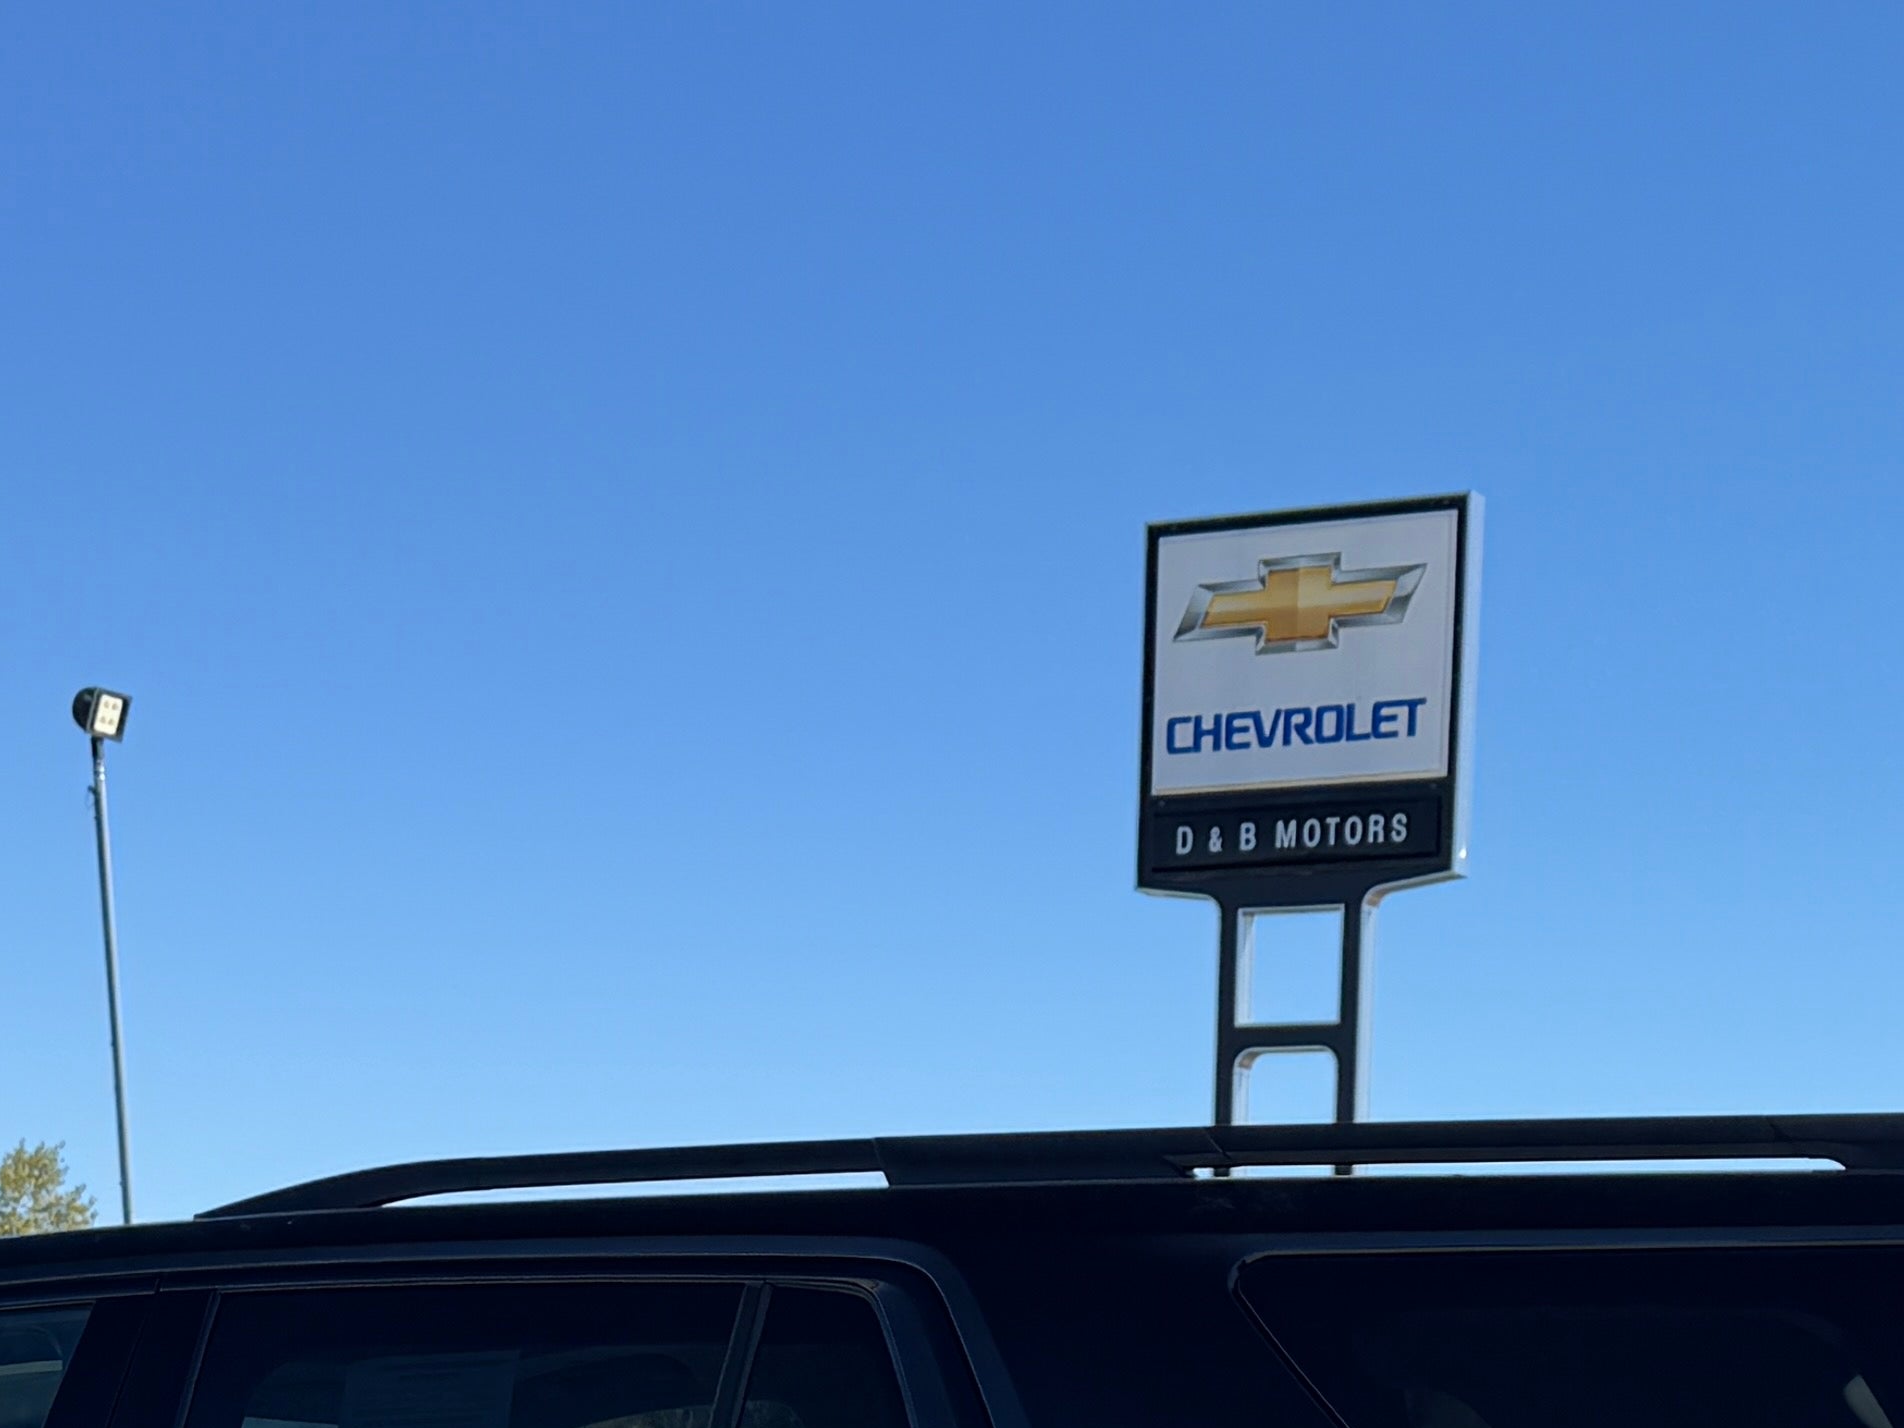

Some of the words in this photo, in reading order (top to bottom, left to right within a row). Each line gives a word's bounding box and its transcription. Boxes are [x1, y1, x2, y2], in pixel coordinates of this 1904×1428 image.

[1166, 698, 1427, 755] CHEVROLET
[1176, 826, 1194, 855] D
[1208, 827, 1223, 853] &
[1239, 823, 1257, 851] B
[1275, 813, 1408, 849] MOTORS
